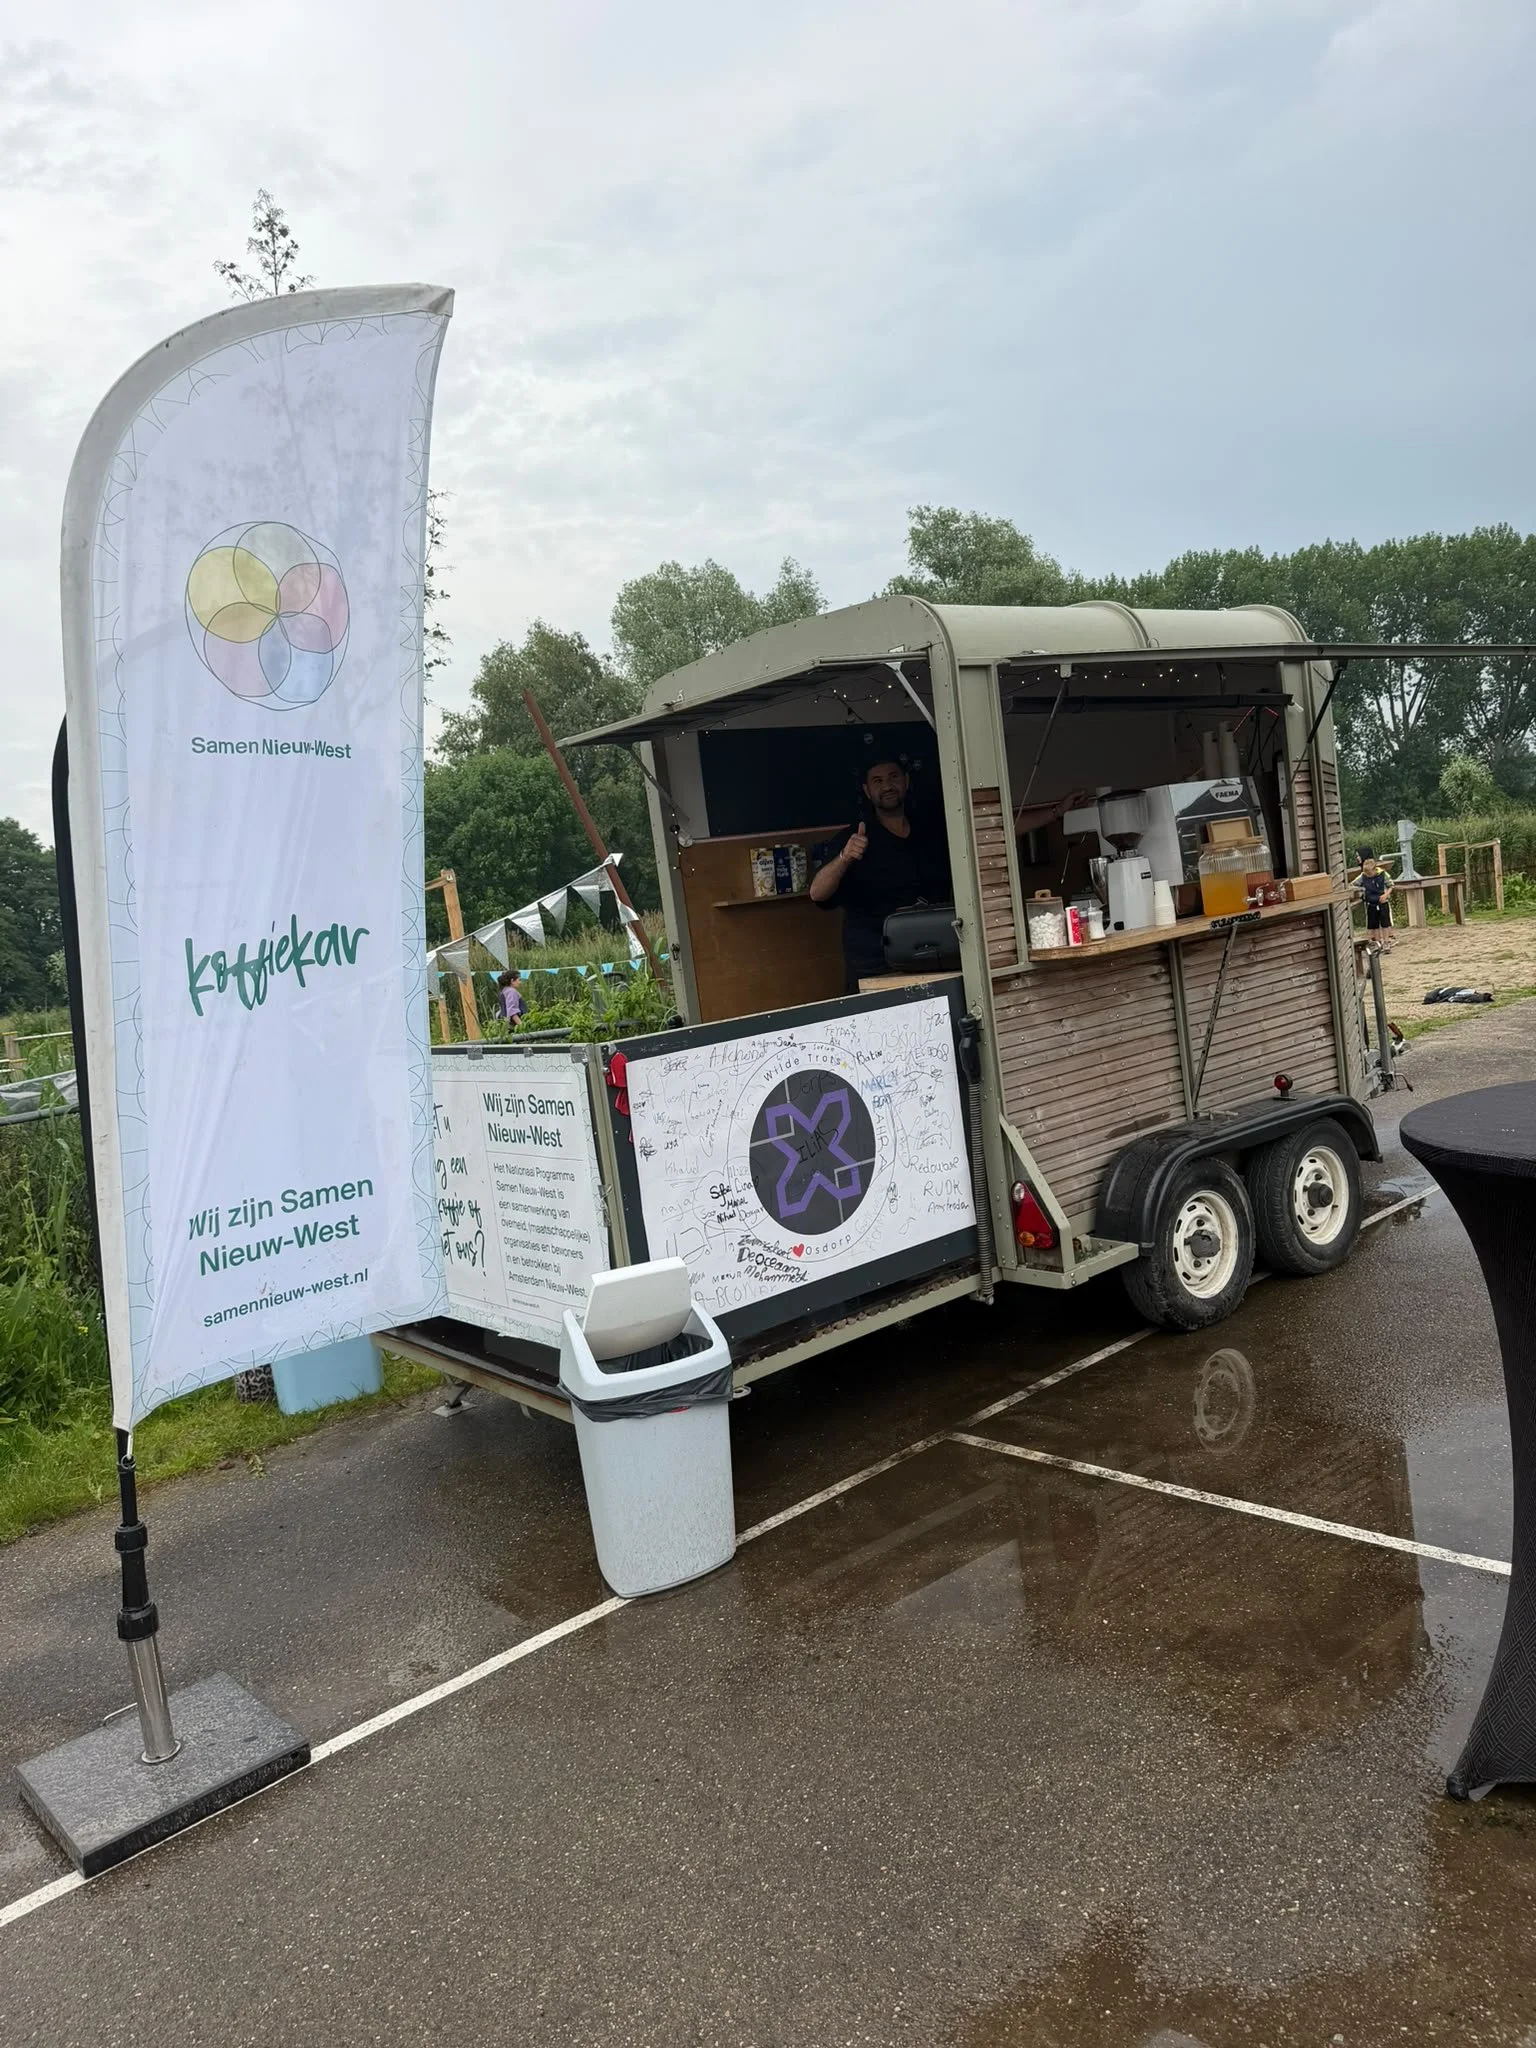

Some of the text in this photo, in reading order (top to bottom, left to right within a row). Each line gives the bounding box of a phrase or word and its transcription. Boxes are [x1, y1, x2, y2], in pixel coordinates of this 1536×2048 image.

[191, 736, 352, 759] Samen Nieuw-West
[1215, 790, 1239, 798] FAEMA
[185, 914, 370, 1016] koffiekar
[763, 1053, 841, 1082] Wilde Trots
[482, 1092, 575, 1118] Wij zijn Samen
[488, 1122, 563, 1148] Nieuw-West
[451, 1156, 468, 1176] een
[505, 1163, 535, 1178] Nationaal
[535, 1167, 575, 1182] Programma
[496, 1180, 518, 1192] Samen
[558, 1188, 565, 1199] is
[188, 1178, 374, 1240] Wij zijn Samen
[468, 1199, 482, 1229] of
[499, 1200, 571, 1220] een samenwerking van
[528, 1221, 591, 1244] (maatschappelijke)
[200, 1214, 360, 1276] Nieuw-West
[503, 1236, 584, 1260] organisaties en bewoners
[805, 1234, 852, 1256] Osdorp
[512, 1254, 520, 1265] en
[521, 1256, 552, 1271] betrokken
[553, 1261, 562, 1277] bij
[508, 1270, 545, 1288] Amsterdam
[203, 1268, 369, 1327] samennieuw-west.nl
